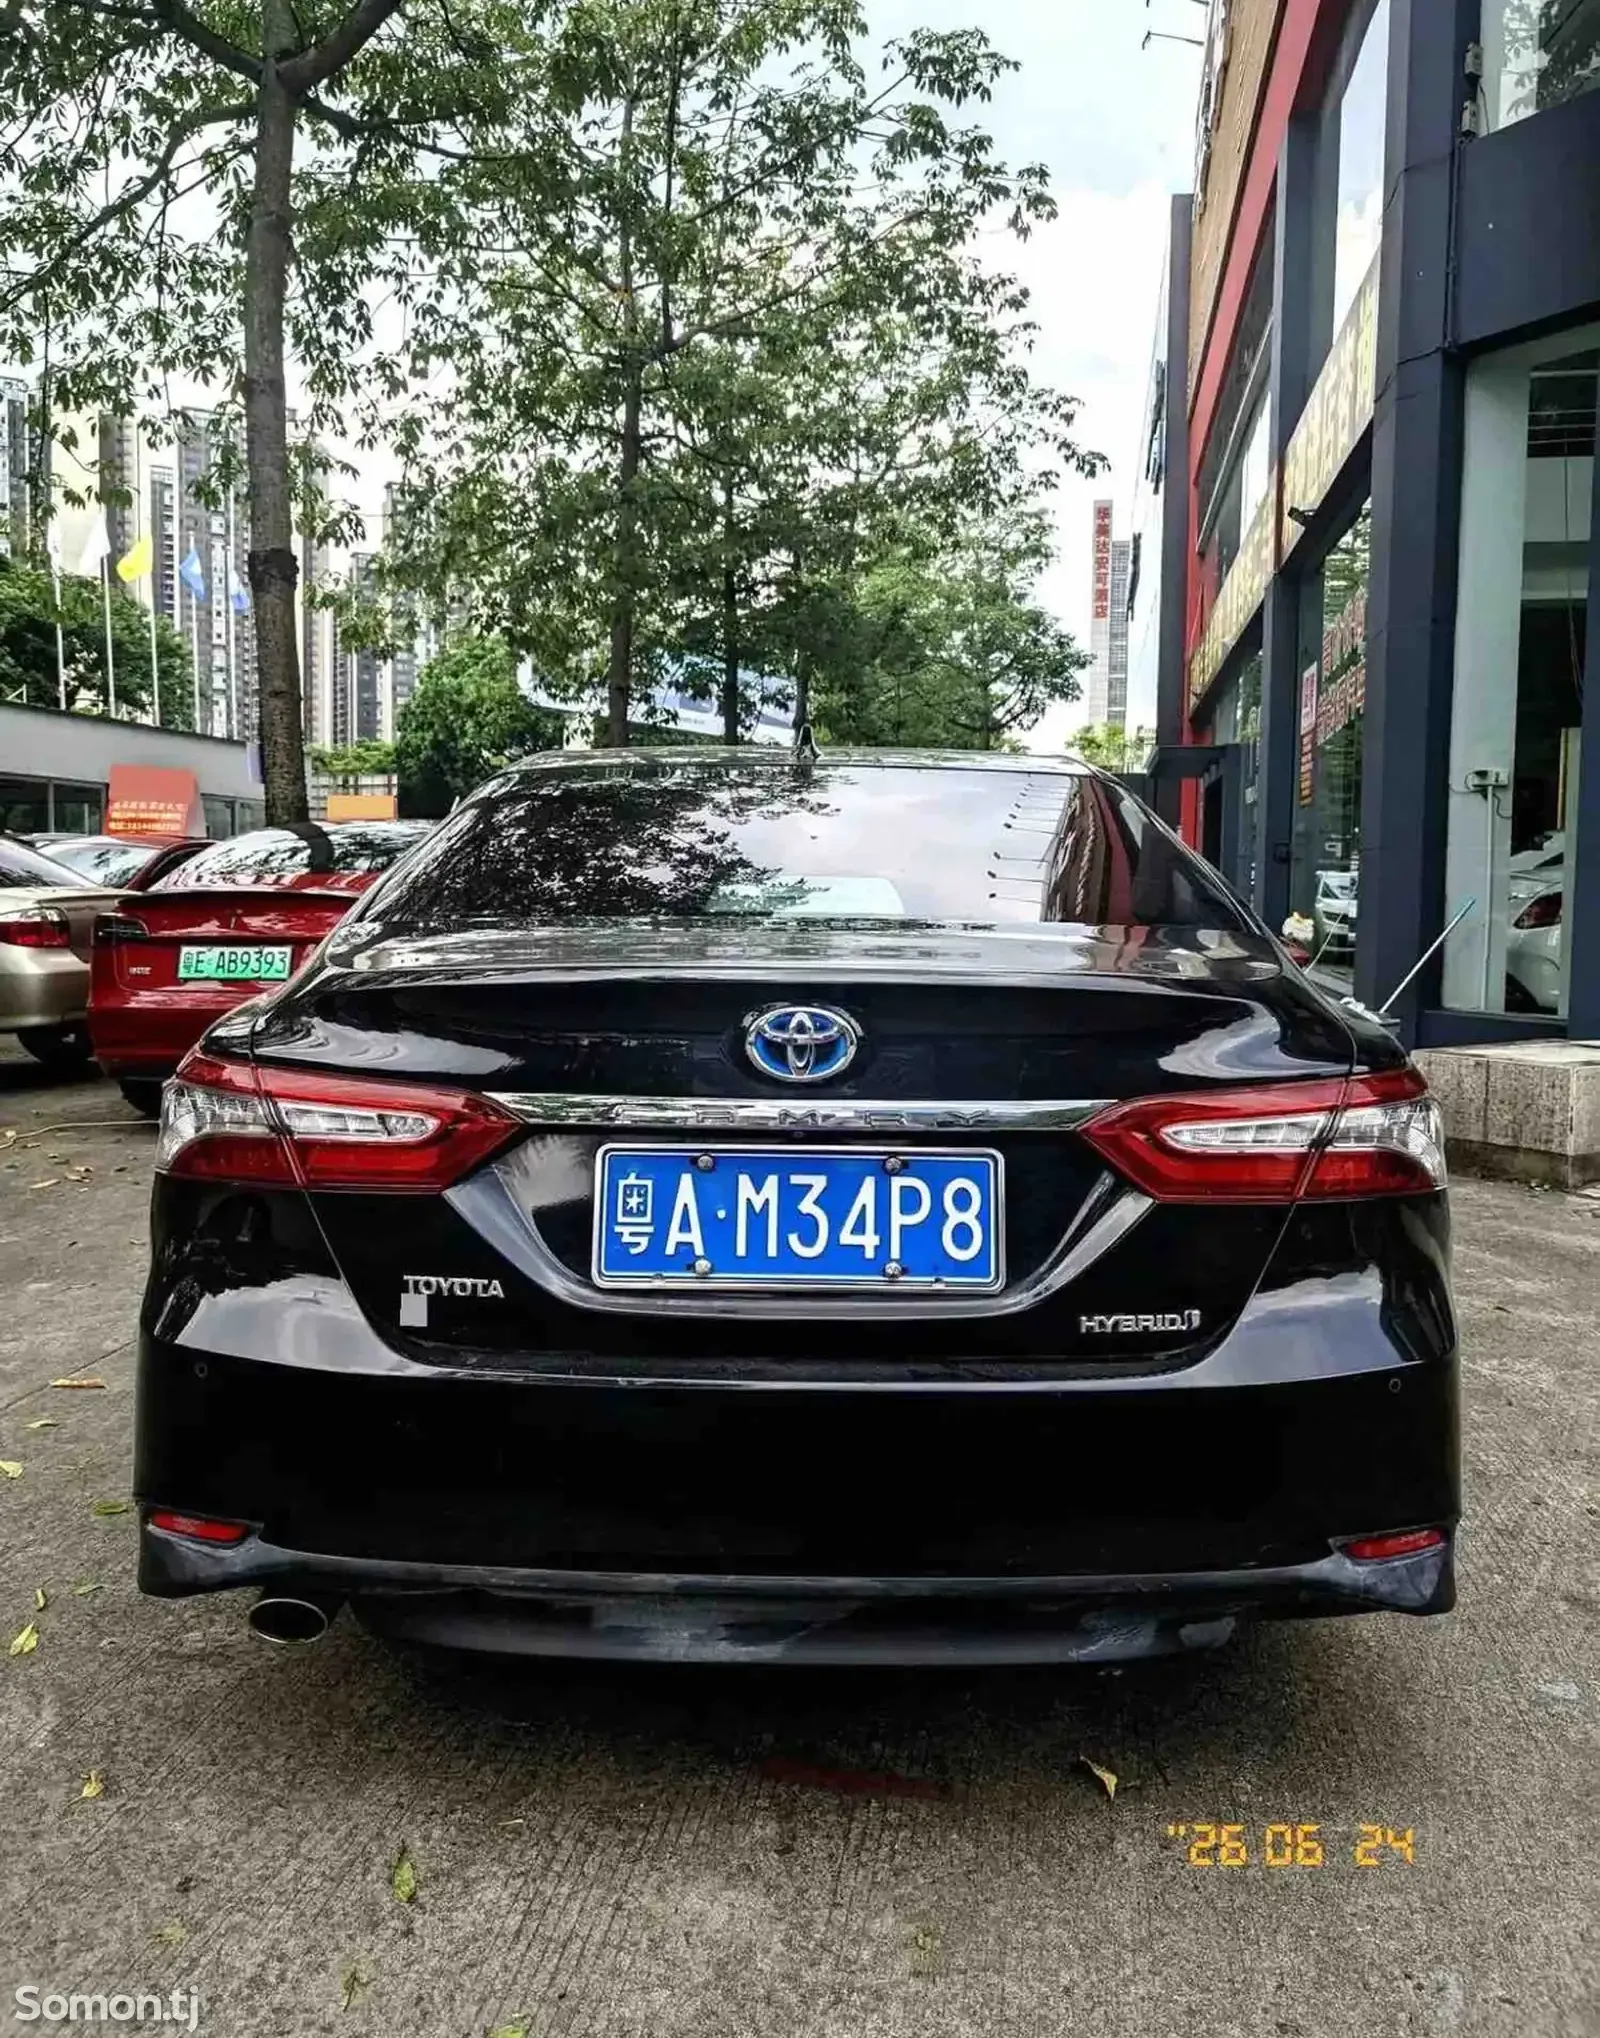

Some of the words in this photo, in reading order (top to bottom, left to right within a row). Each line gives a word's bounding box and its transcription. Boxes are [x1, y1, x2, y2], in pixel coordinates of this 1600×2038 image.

[1096, 507, 1110, 619] 华美达安可酒店
[403, 1275, 504, 1298] TOYOTA
[1080, 1314, 1182, 1333] HYBRID
